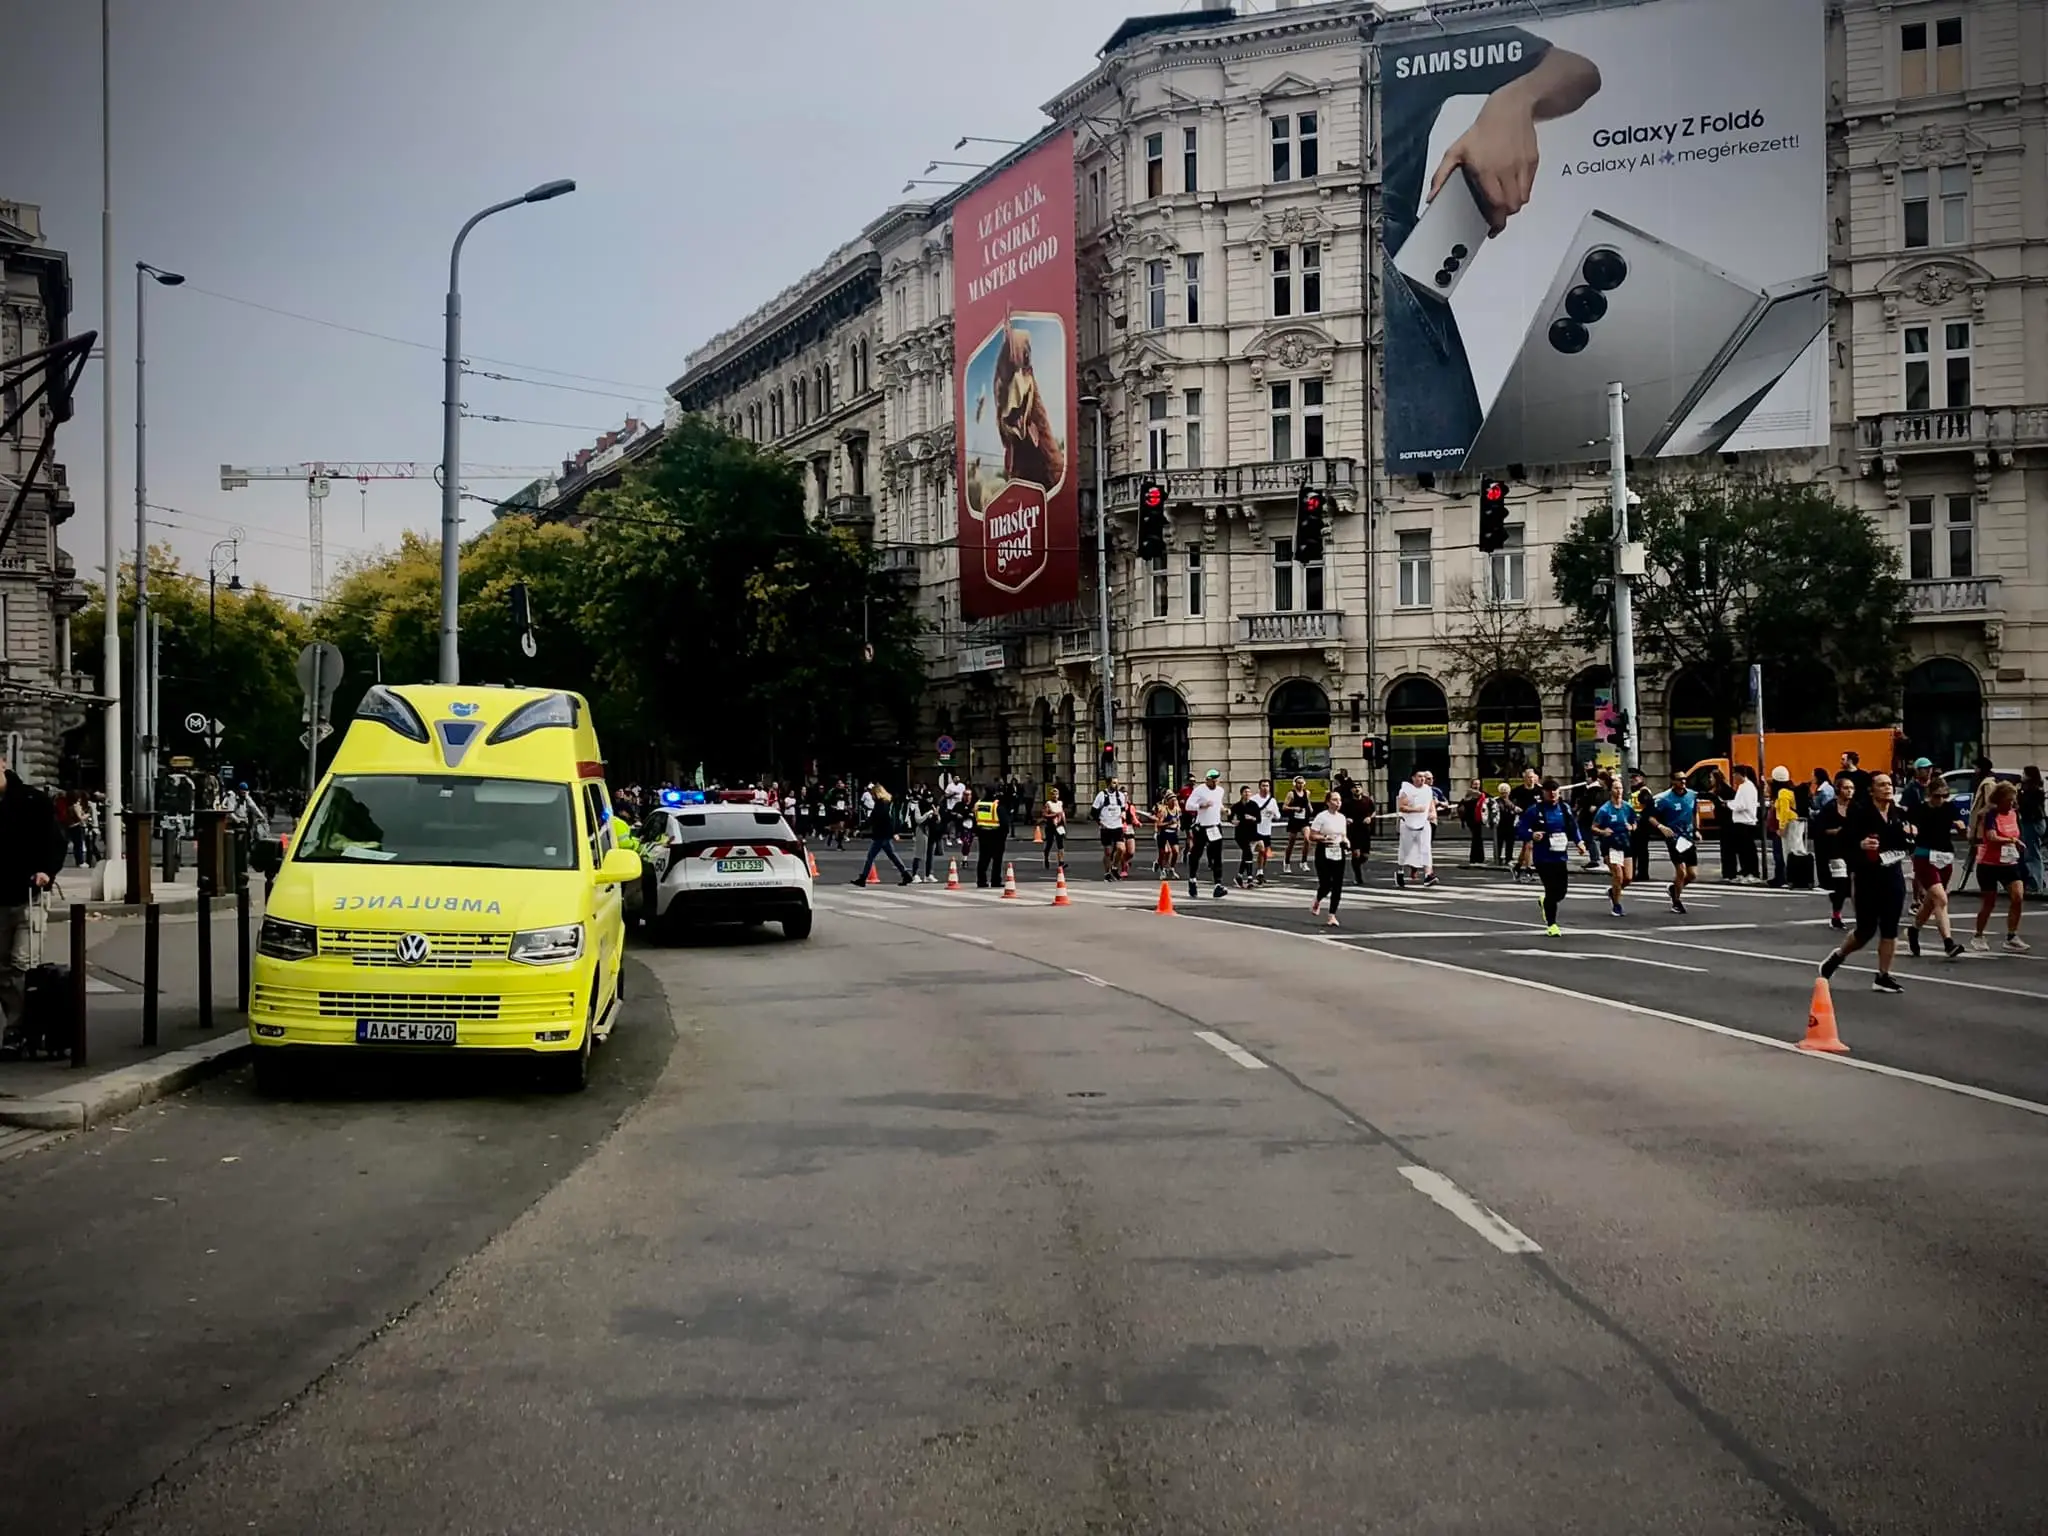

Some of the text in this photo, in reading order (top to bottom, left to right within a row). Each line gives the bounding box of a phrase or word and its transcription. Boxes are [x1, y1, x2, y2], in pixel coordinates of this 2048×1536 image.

[1396, 41, 1522, 78] SAMSUNG
[1593, 109, 1764, 147] Galaxy Z Fold6
[1562, 135, 1799, 176] A Galaxy AI megérkezett!
[977, 214, 993, 241] AZ
[995, 200, 1012, 231] ÉG
[982, 213, 1040, 267] A CSIRKE
[968, 235, 1058, 304] MASTER GOOD
[1400, 447, 1464, 460] samsung.com
[989, 500, 1040, 540] master
[997, 526, 1032, 573] good
